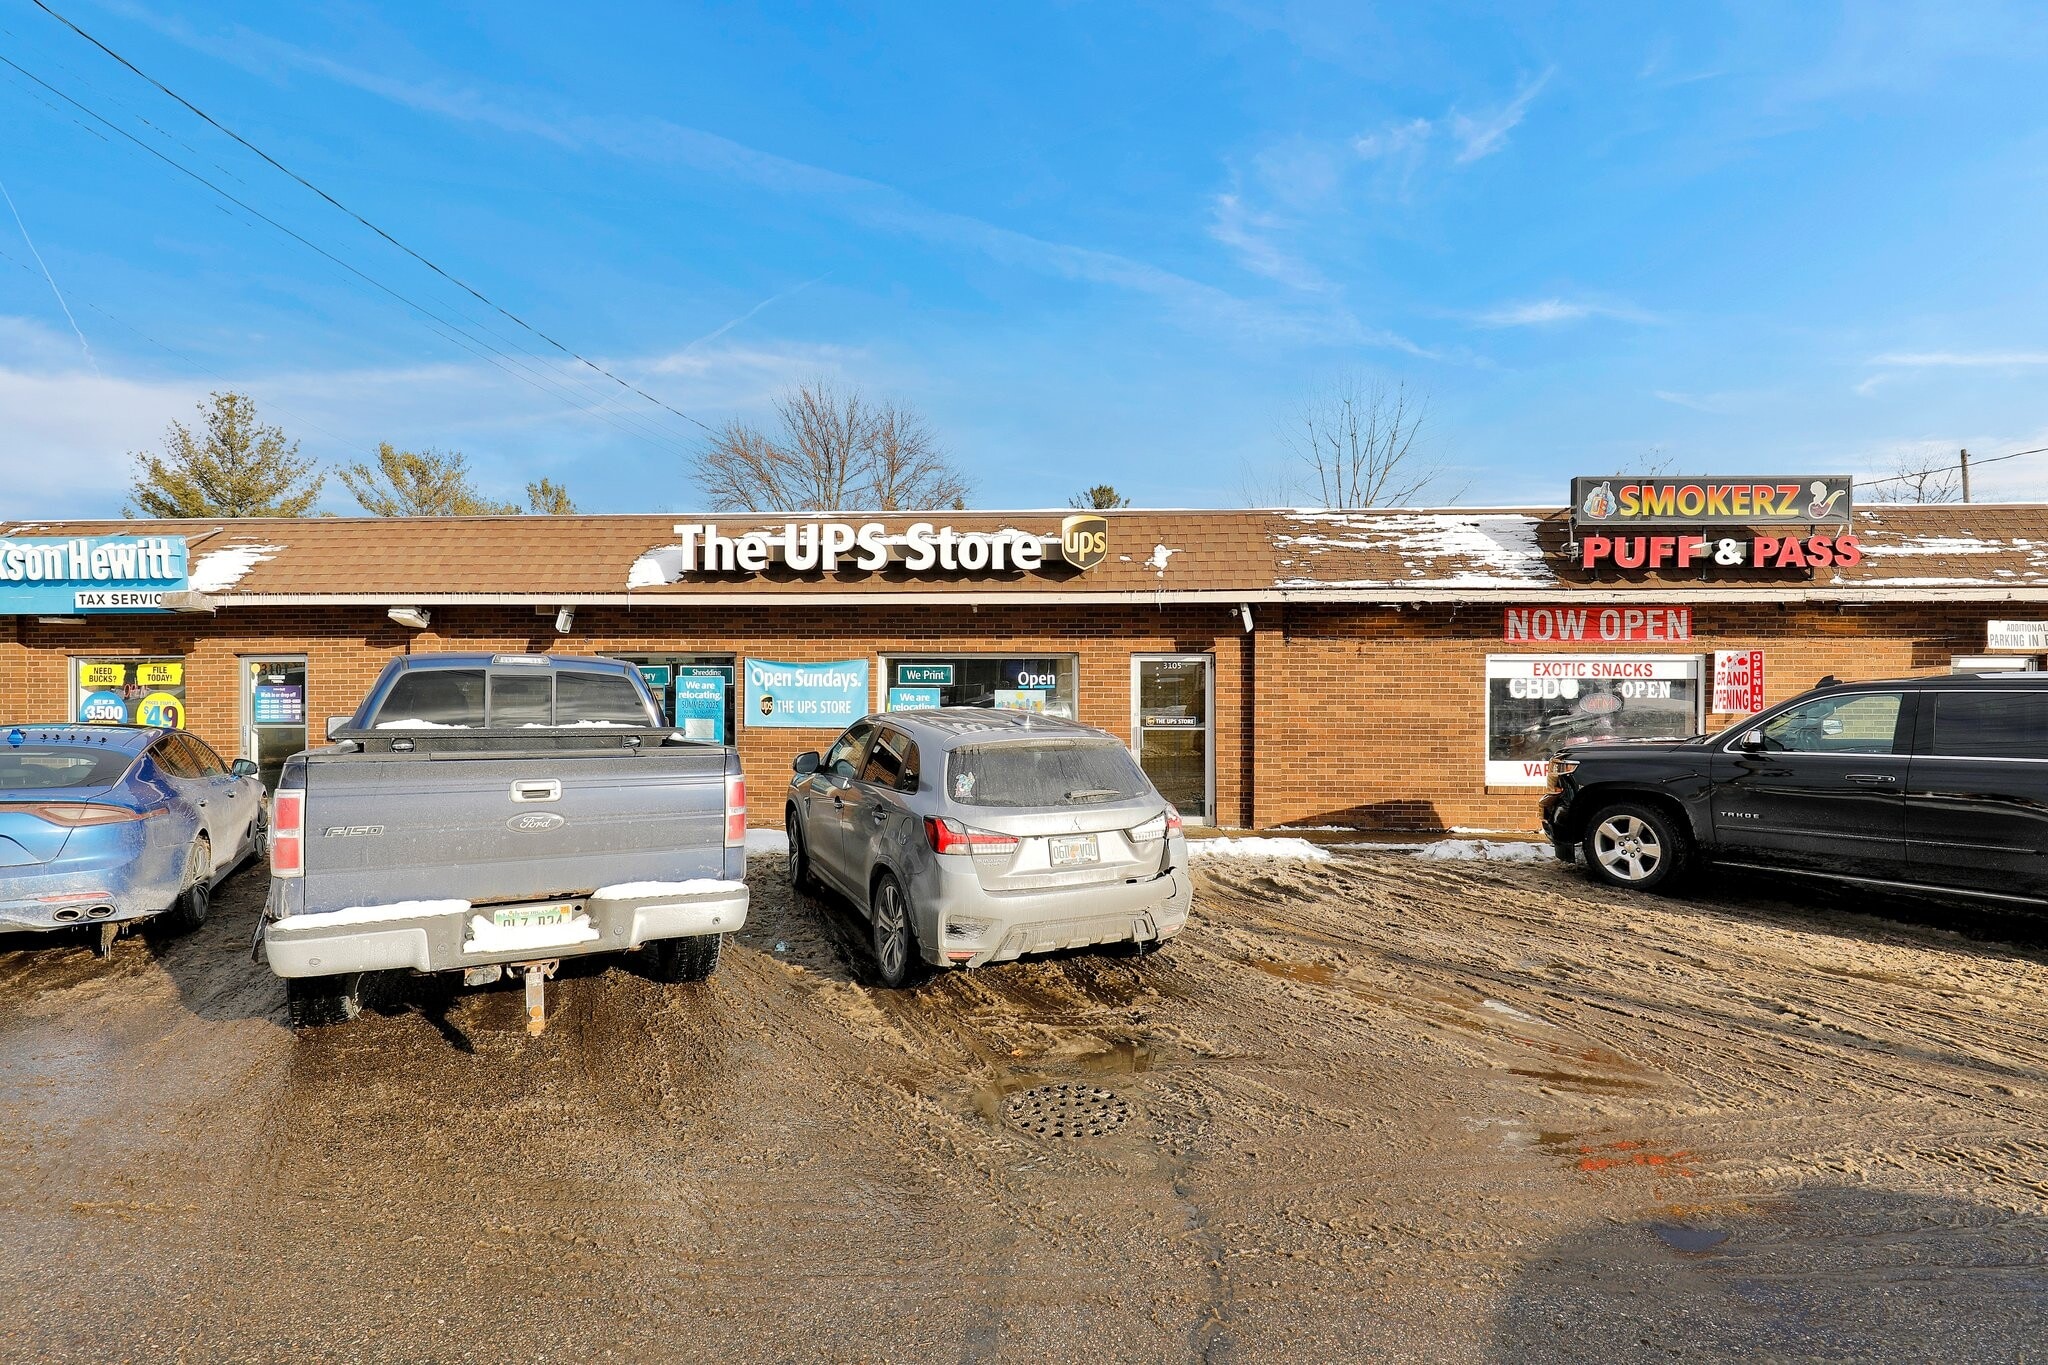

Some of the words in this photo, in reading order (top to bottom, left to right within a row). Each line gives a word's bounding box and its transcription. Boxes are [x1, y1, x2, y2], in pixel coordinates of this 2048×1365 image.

[1619, 485, 1800, 516] SMOKERZ
[674, 524, 769, 571] The
[784, 523, 887, 571] UPS
[906, 522, 1042, 570] Store
[1064, 531, 1106, 561] ups
[1583, 536, 1706, 568] PUFF
[1714, 538, 1744, 565] &
[1754, 535, 1862, 568] PASS
[68, 539, 174, 580] Hewitt
[79, 593, 106, 605] TAX
[111, 593, 162, 605] SERVIC
[1507, 609, 1587, 641] NOW
[1600, 609, 1689, 641] OPEN
[2006, 623, 2048, 632] ADDITIONAL
[1990, 633, 2025, 647] PARKING
[2029, 634, 2039, 647] IN
[906, 670, 921, 680] We
[923, 670, 945, 680] Print
[1533, 663, 1586, 677] EXOTIC
[1591, 663, 1653, 677] SNACKS
[89, 675, 117, 683] BUCKS?
[147, 674, 172, 682] TODAY!
[752, 667, 792, 691] Open
[795, 668, 862, 692] Sundays.
[1018, 671, 1056, 688] Open
[1716, 671, 1749, 686] GRAND
[1752, 653, 1762, 710] OPENING
[679, 691, 722, 700] relocating.
[1509, 678, 1560, 699] CBD
[1621, 681, 1672, 699] OPEN
[900, 693, 914, 701] We
[1714, 689, 1749, 710] OPENING
[776, 700, 794, 713] THE
[798, 700, 817, 713] UPS
[820, 700, 851, 713] STORE
[520, 816, 552, 828] Ford
[1721, 811, 1760, 819] TAHOE
